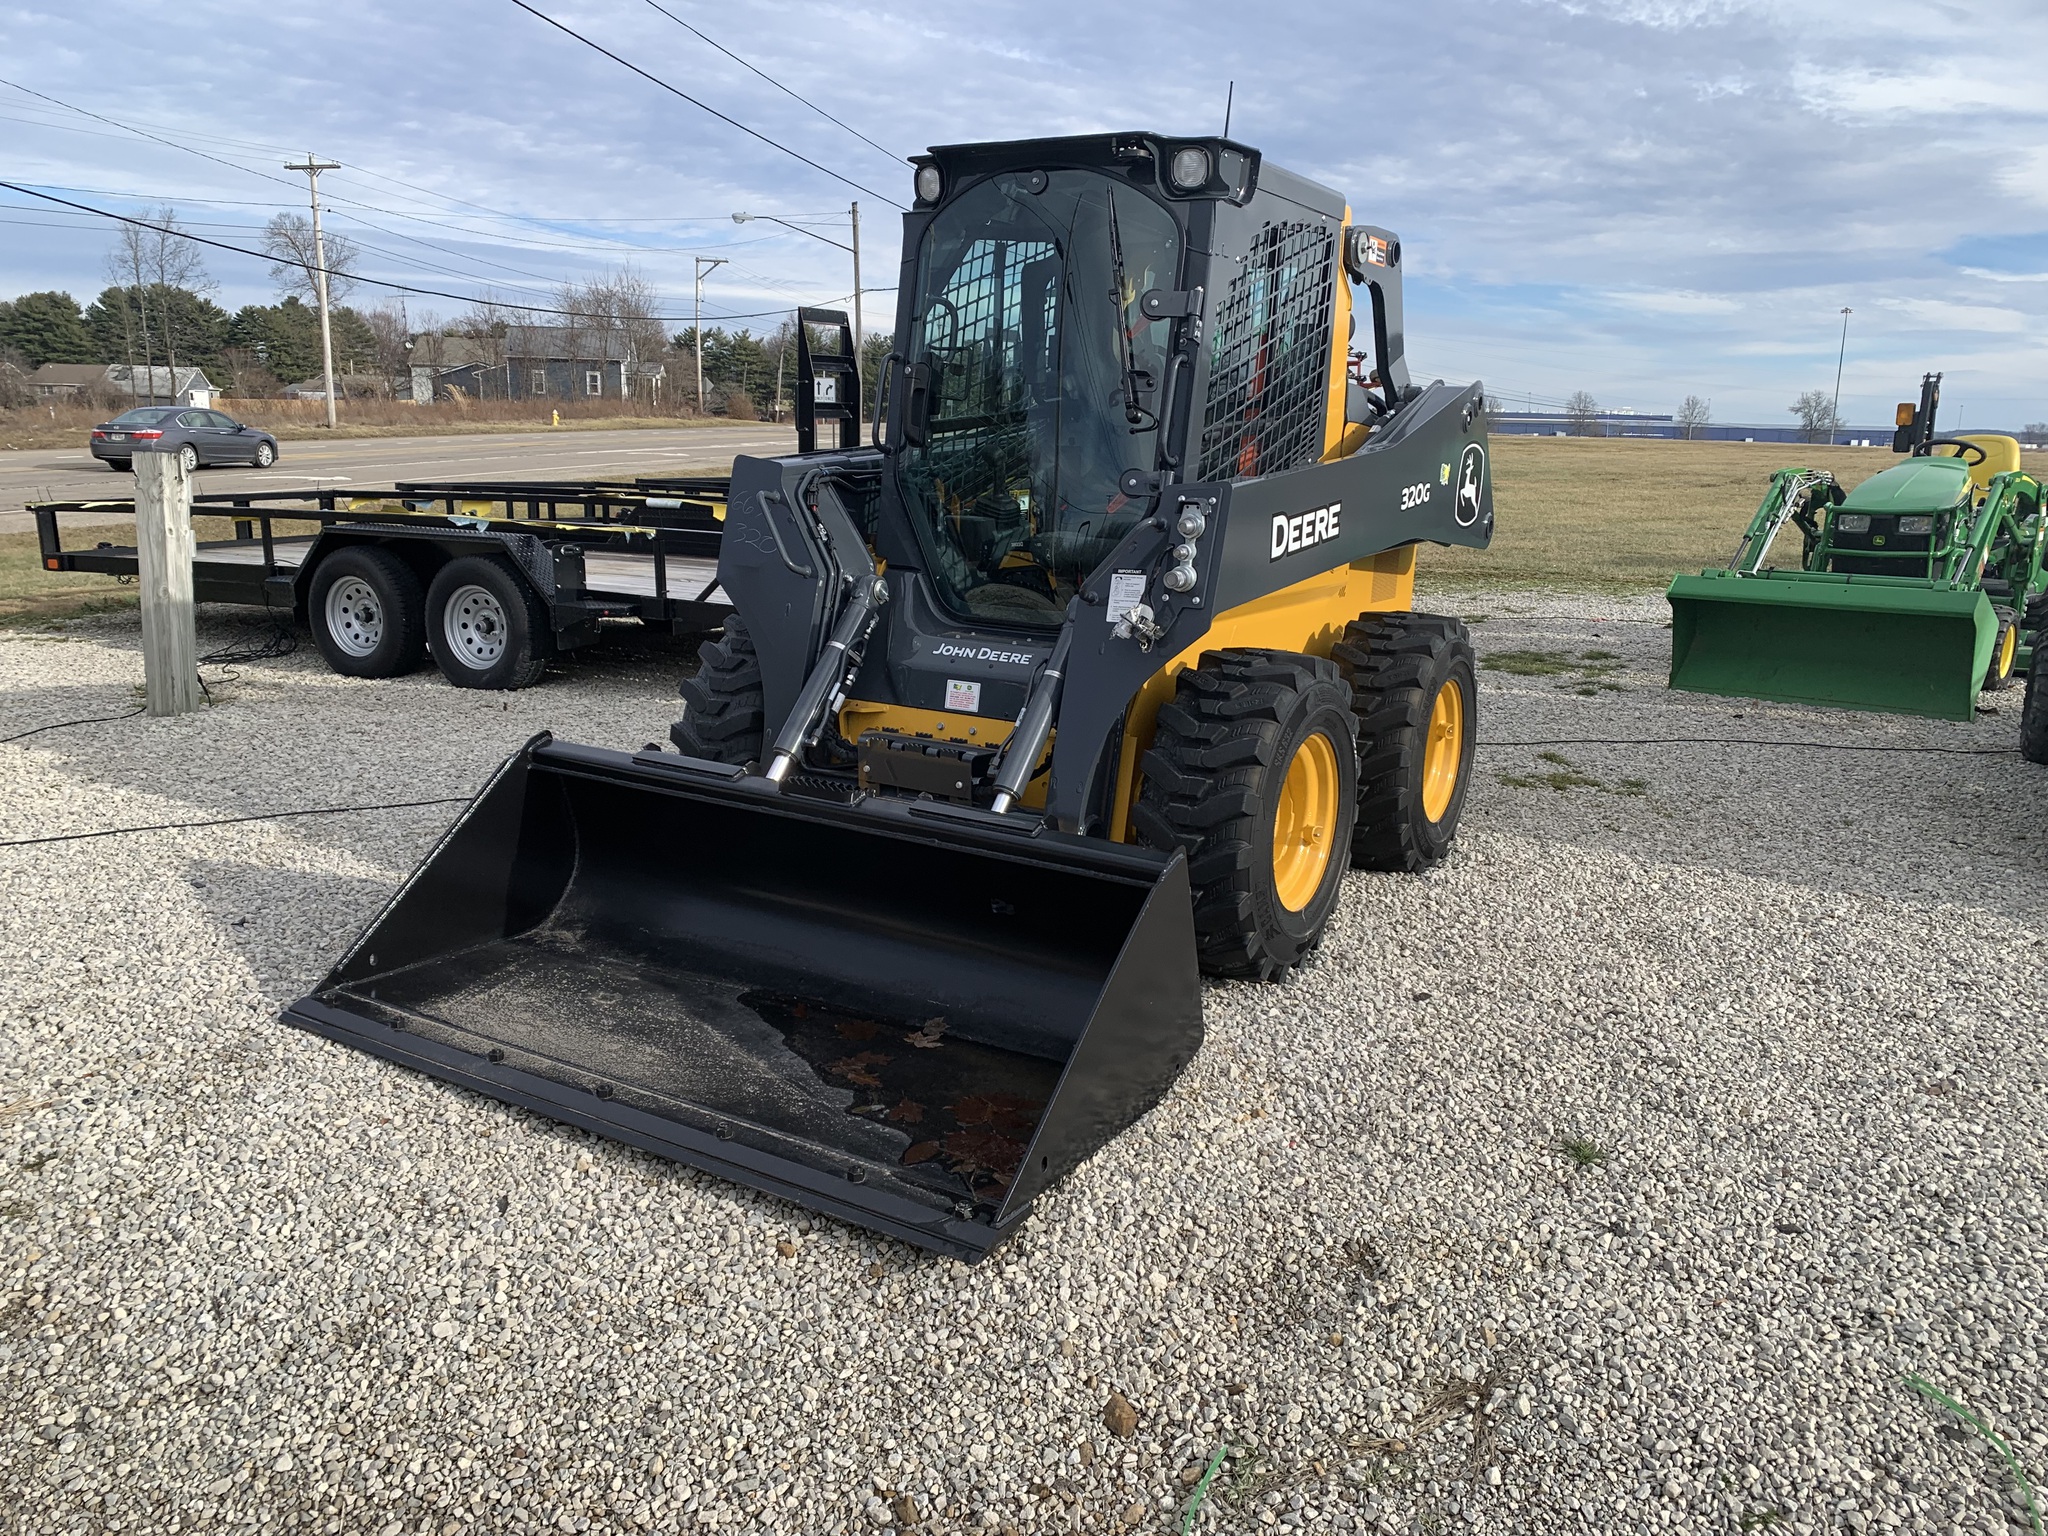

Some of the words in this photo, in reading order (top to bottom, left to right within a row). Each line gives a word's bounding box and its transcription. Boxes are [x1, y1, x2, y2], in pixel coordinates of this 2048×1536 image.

[1400, 482, 1431, 511] 320G
[733, 522, 777, 553] 320
[1270, 502, 1342, 560] DEERE
[932, 643, 977, 659] JOHN
[976, 647, 1033, 665] DEERE
